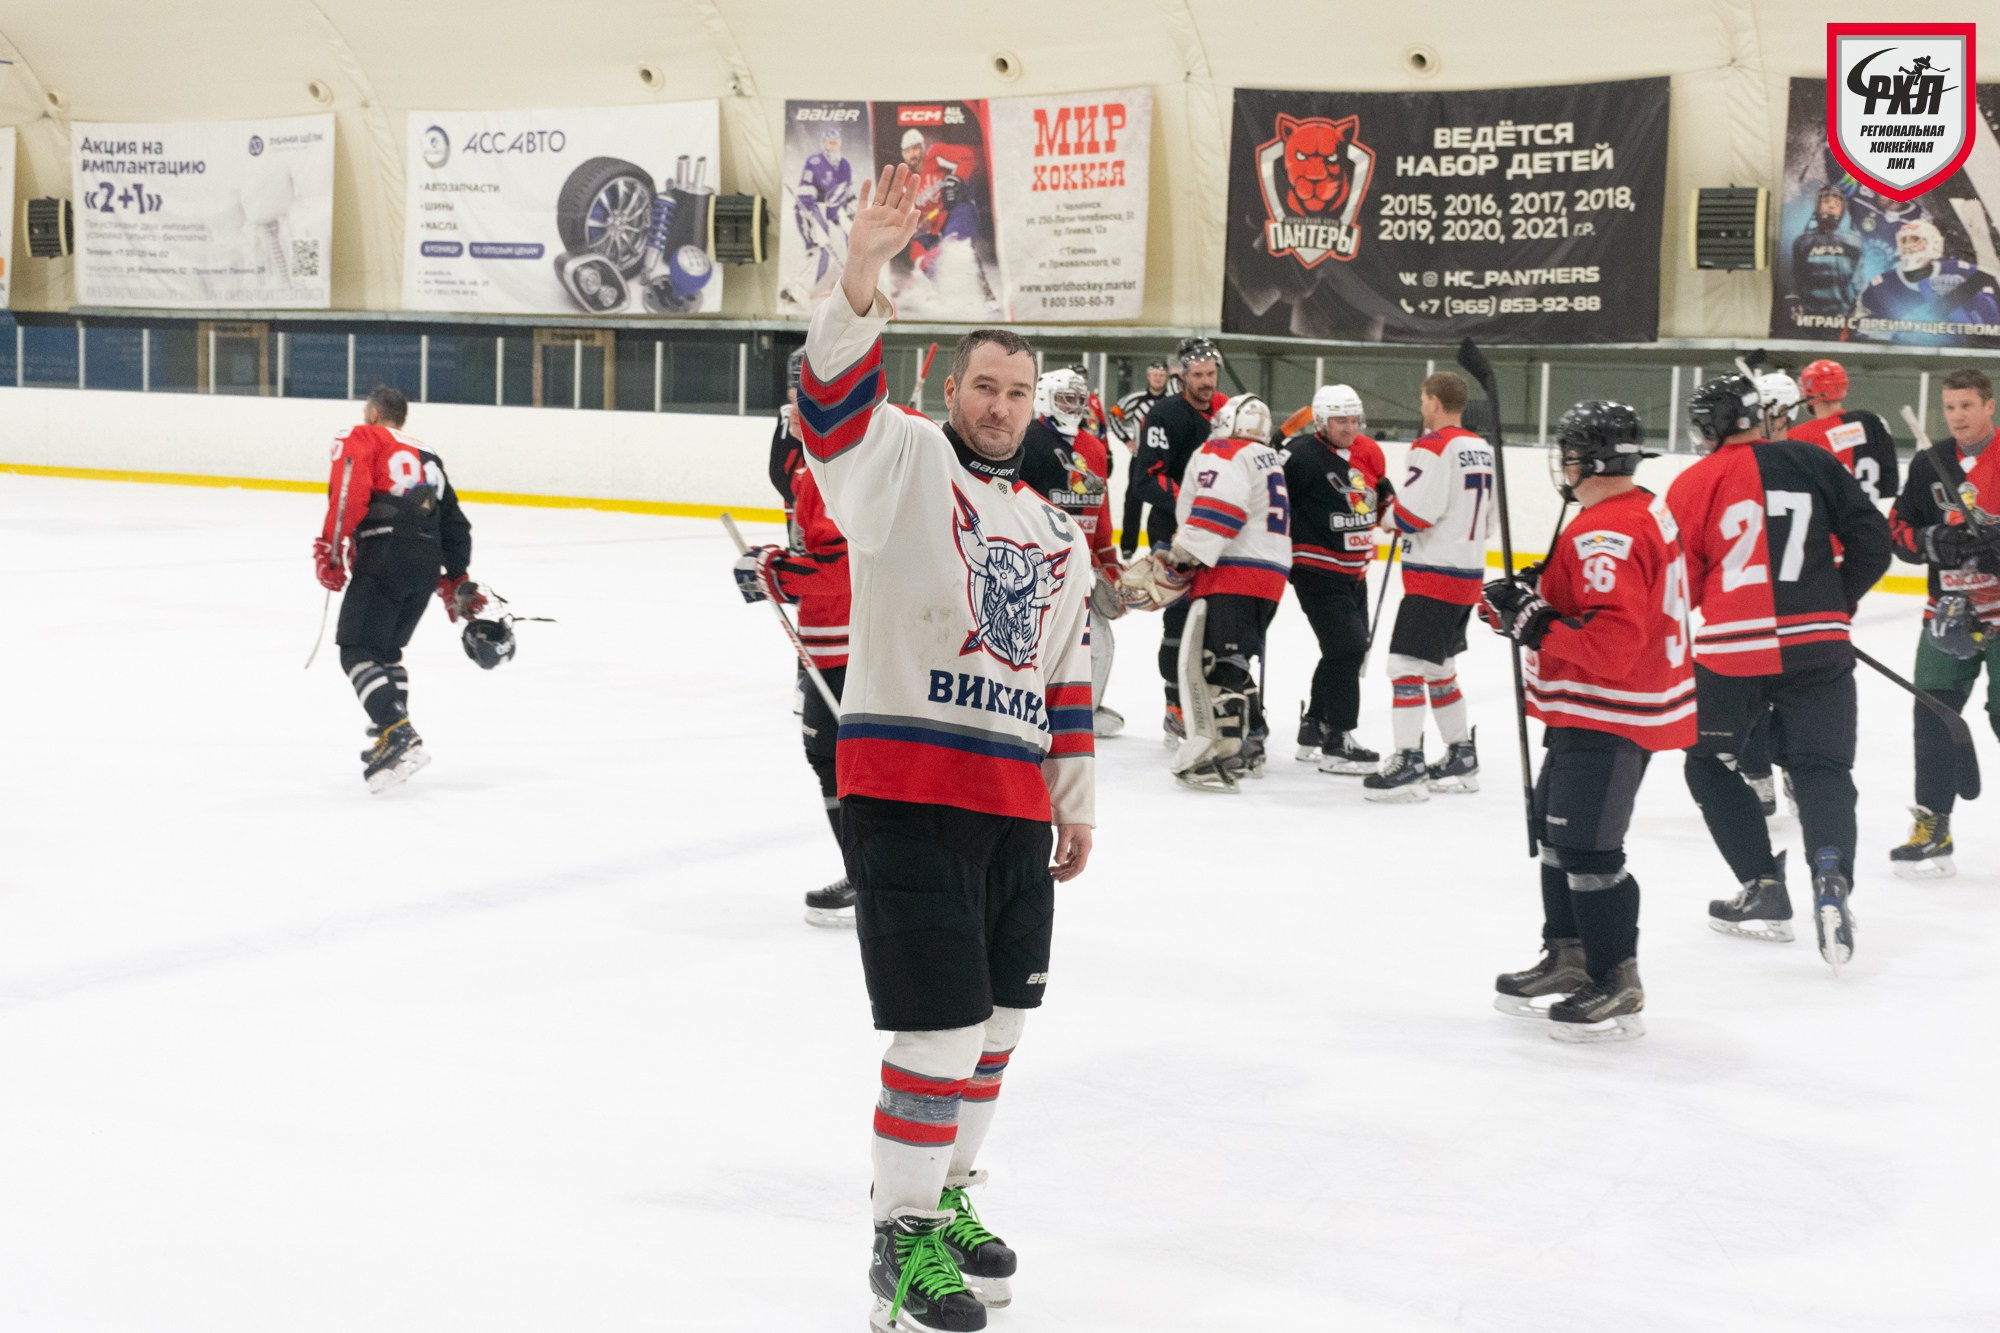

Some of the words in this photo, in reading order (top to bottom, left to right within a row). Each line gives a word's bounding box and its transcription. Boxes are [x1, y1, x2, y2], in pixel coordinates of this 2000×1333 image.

[900, 110, 942, 122] CCM
[462, 129, 567, 155] АССАВТО
[1032, 103, 1127, 158] МИР
[1432, 119, 1575, 153] ВЕДЁТСЯ
[80, 136, 137, 156] Акция
[142, 141, 163, 155] на
[81, 159, 207, 176] имплантацию
[1395, 154, 1500, 178] НАБОР
[1505, 141, 1616, 181] ДЕТЕЙ
[423, 182, 501, 193] АВТОЗАПЧАСТИ
[1031, 160, 1126, 192] ХОККЕЯ
[84, 181, 163, 214] «2+1»
[1379, 193, 1438, 221] 2015,
[1443, 192, 1503, 219] 2016,
[1508, 189, 1568, 216] 2017,
[1573, 185, 1637, 213] 2018,
[1269, 222, 1358, 255] ПАНТЕРЫ
[1378, 219, 1436, 246] 2019,
[1440, 218, 1506, 245] 2020,
[1511, 217, 1569, 241] 2021
[1443, 265, 1602, 290] HC_PANTHERS
[1049, 296, 1067, 308] 800
[1418, 298, 1442, 314] +7
[1444, 295, 1497, 318] (965)
[1499, 295, 1602, 314] 853-92-88
[1796, 314, 1845, 329] ИГРАЙ
[1847, 319, 1857, 329] С
[968, 460, 1015, 477] BAUER
[1719, 490, 1813, 593] 27
